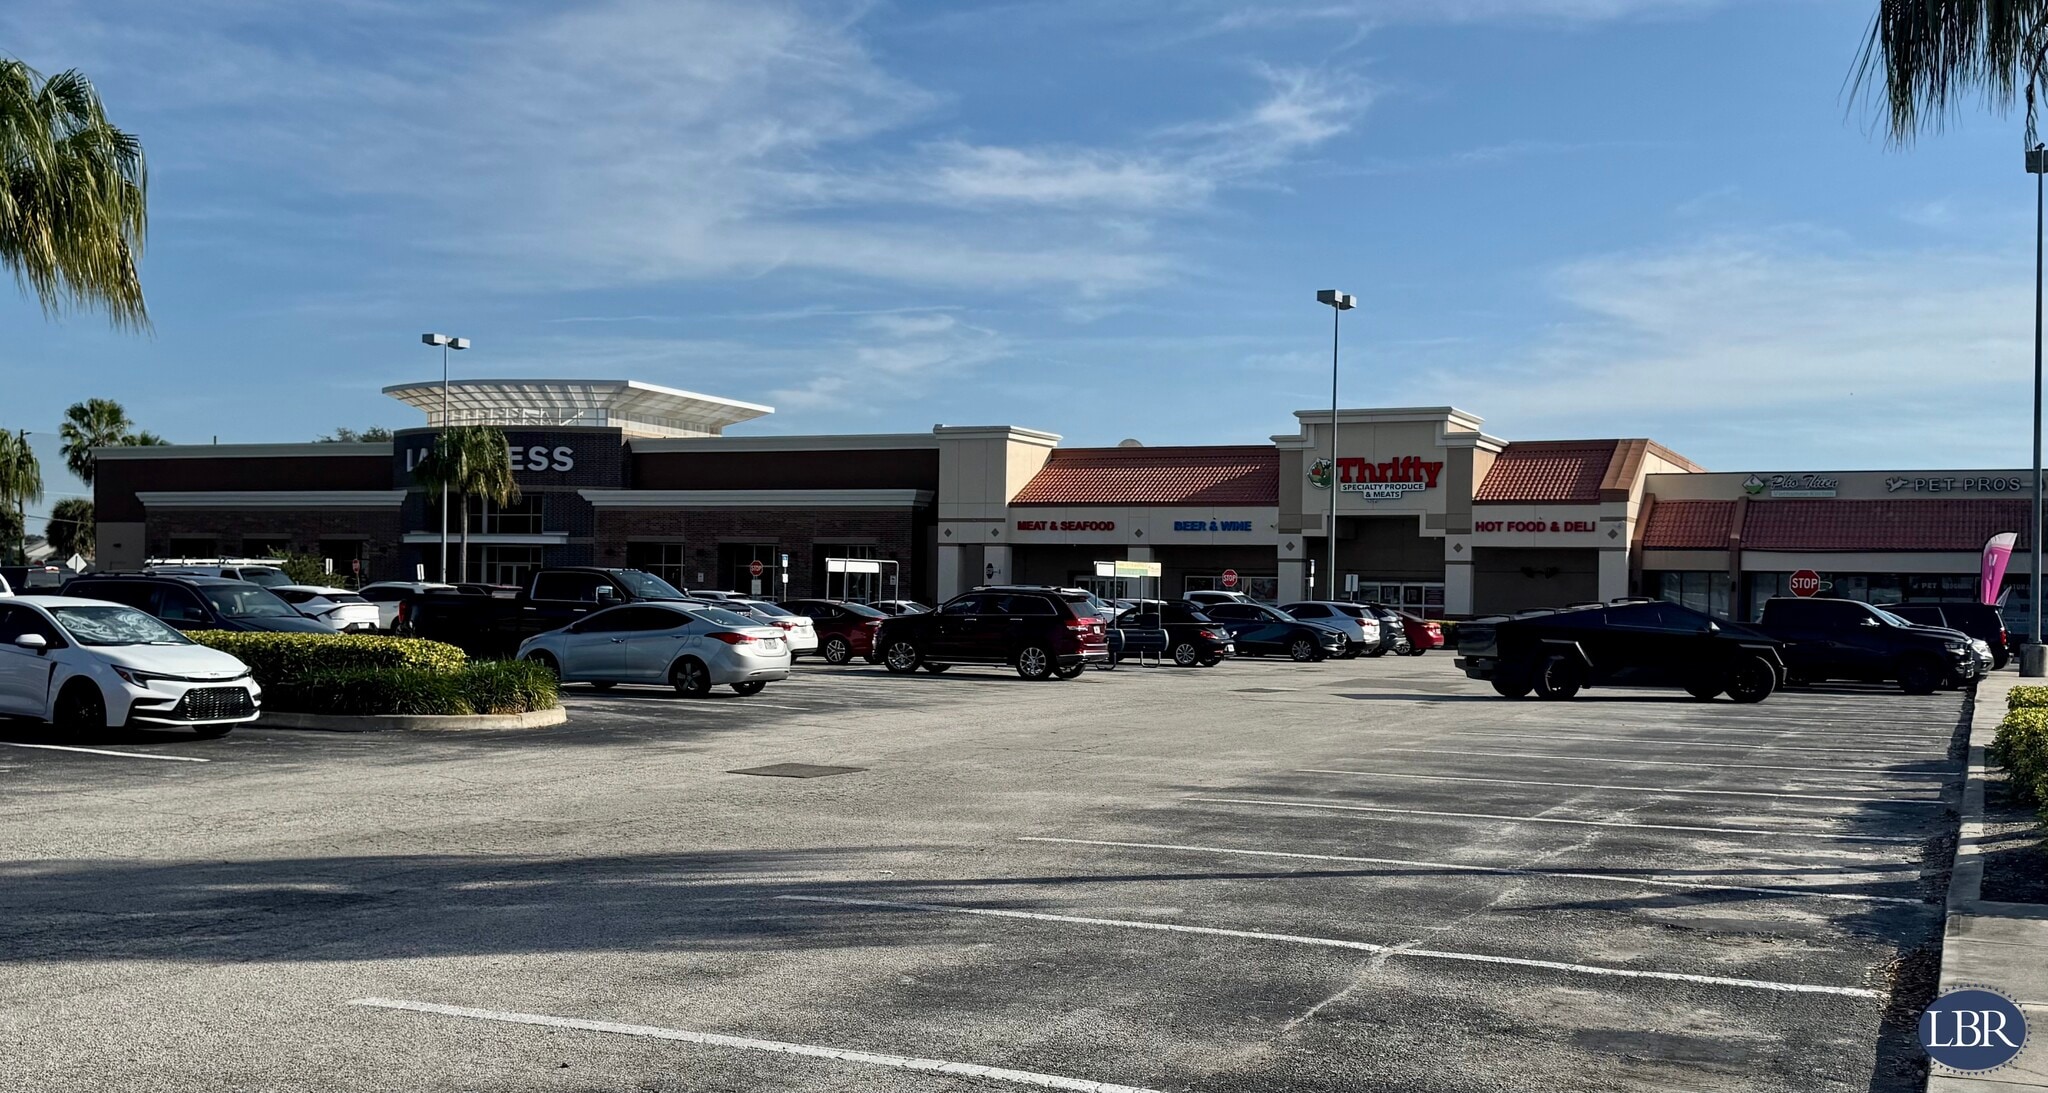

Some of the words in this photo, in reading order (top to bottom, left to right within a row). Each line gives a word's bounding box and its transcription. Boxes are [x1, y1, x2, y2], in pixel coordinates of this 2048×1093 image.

[1336, 456, 1443, 488] Thrifty
[1342, 483, 1384, 491] SPECIALTY
[1771, 474, 1798, 489] Pho
[1802, 474, 1838, 489] Thien
[1914, 478, 1955, 491] PET
[1963, 477, 2021, 491] PROS
[1017, 521, 1047, 531] MEAT
[1049, 521, 1058, 531] &
[1060, 521, 1115, 531] SEAFOOD
[1174, 521, 1206, 531] BEER
[1209, 521, 1218, 531] &
[1220, 521, 1252, 531] WINE
[1475, 521, 1504, 532] HOT
[1507, 521, 1546, 532] FOOD
[1550, 521, 1560, 532] &
[1564, 521, 1595, 532] DELI
[1223, 574, 1237, 582] STOP
[1791, 577, 1818, 589] STOP
